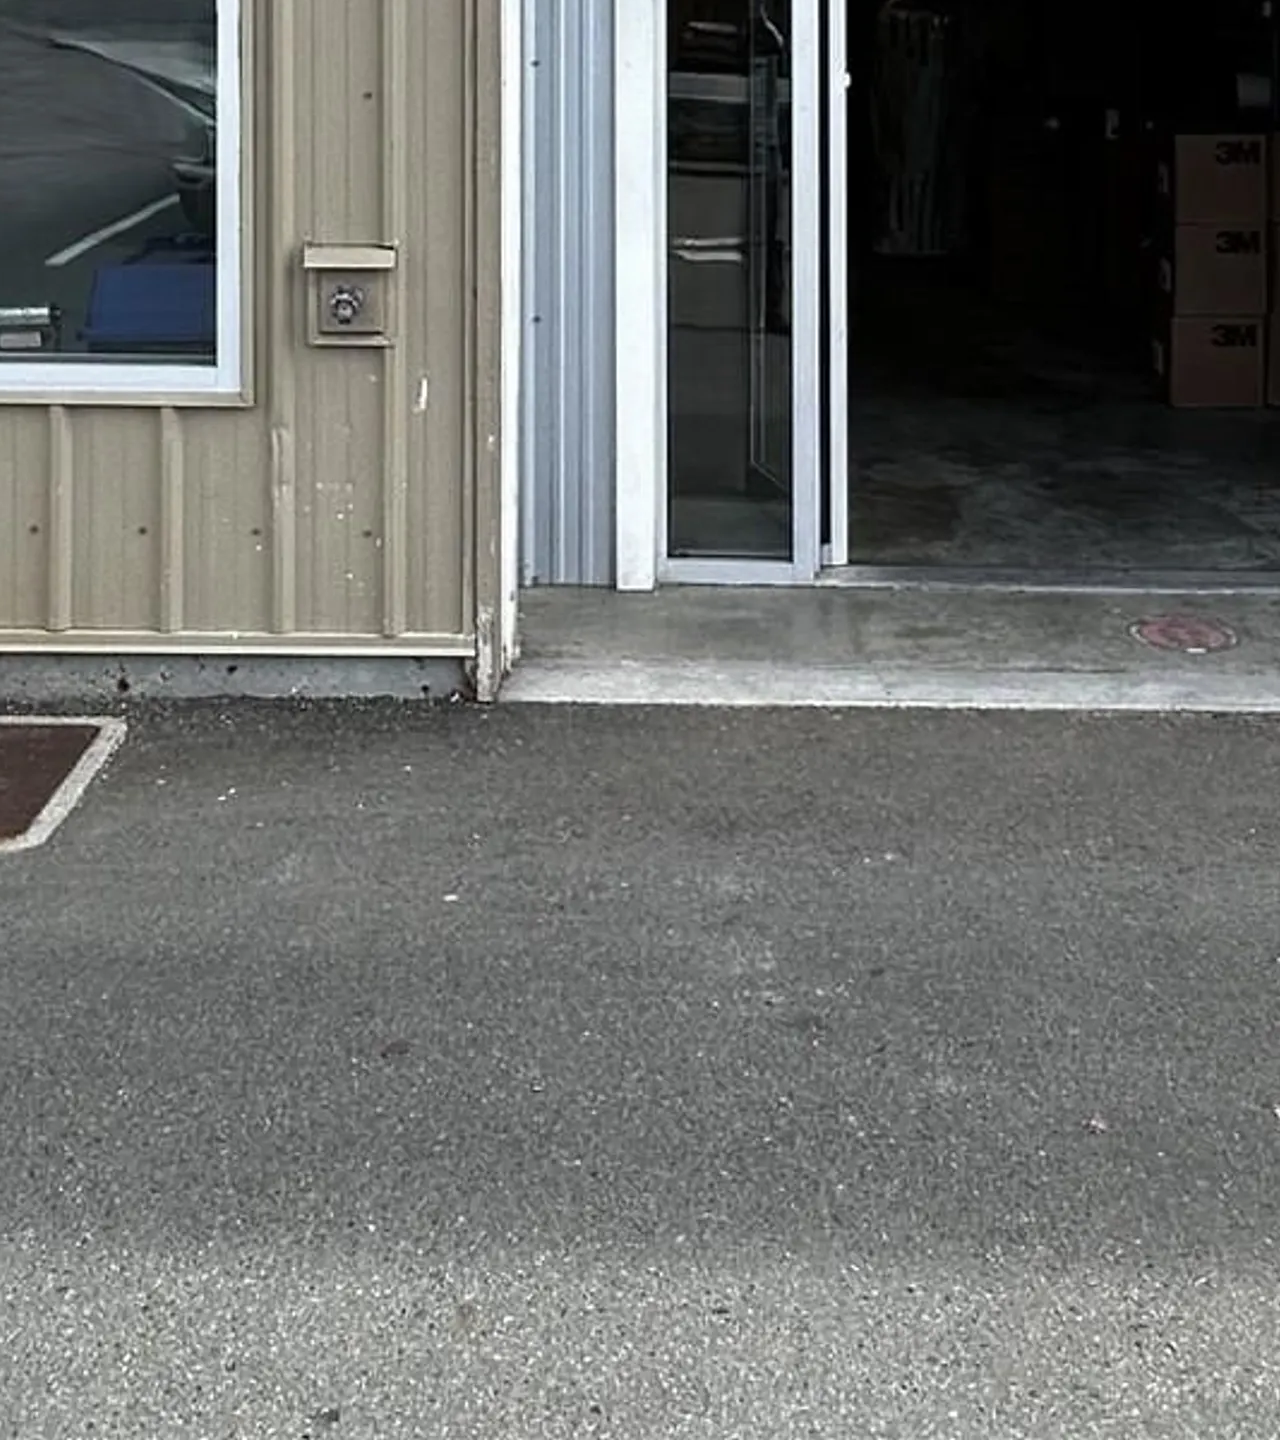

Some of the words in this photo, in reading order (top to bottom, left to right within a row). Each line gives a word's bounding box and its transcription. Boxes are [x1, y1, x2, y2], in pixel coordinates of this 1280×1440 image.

[1215, 140, 1261, 166] 3M
[1216, 230, 1261, 255] 3M
[1210, 323, 1257, 348] 3M
